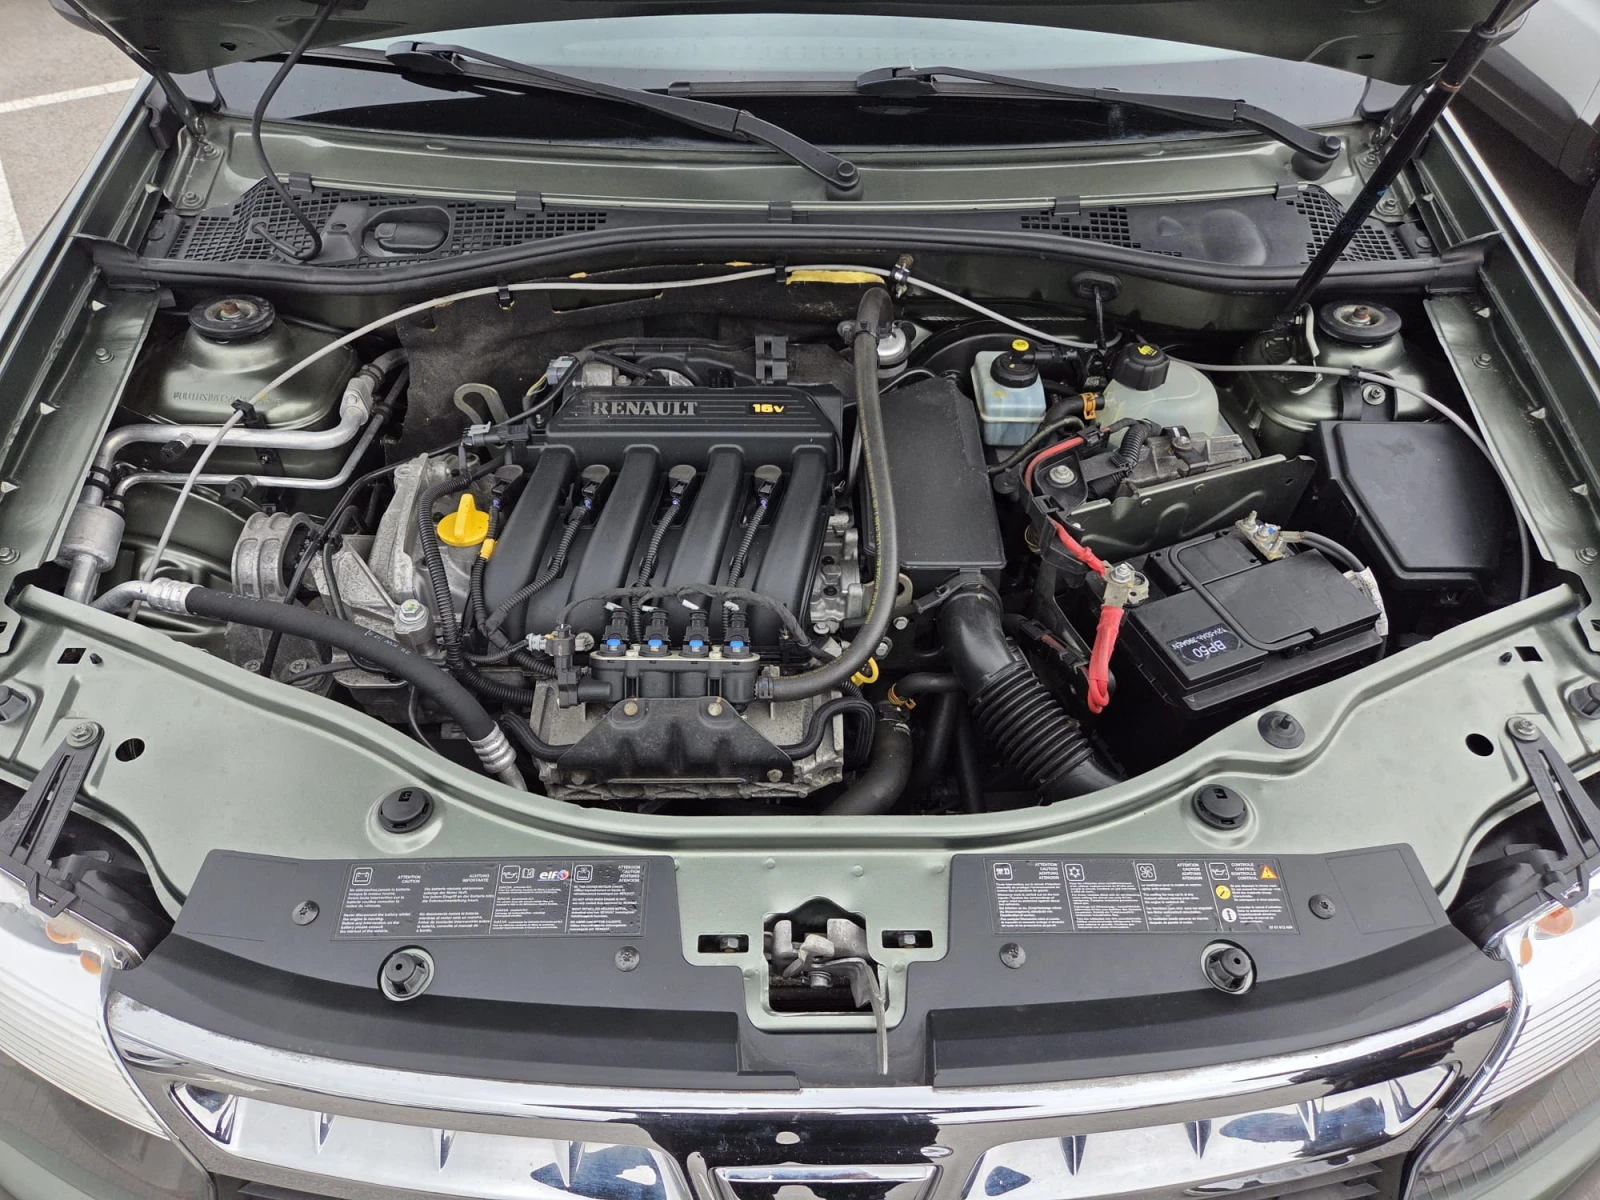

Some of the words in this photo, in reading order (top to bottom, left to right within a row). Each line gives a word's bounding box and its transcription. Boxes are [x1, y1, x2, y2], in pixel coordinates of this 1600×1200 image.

[593, 402, 698, 415] RENAULT
[1192, 640, 1226, 658] BP50
[539, 870, 558, 880] elf
